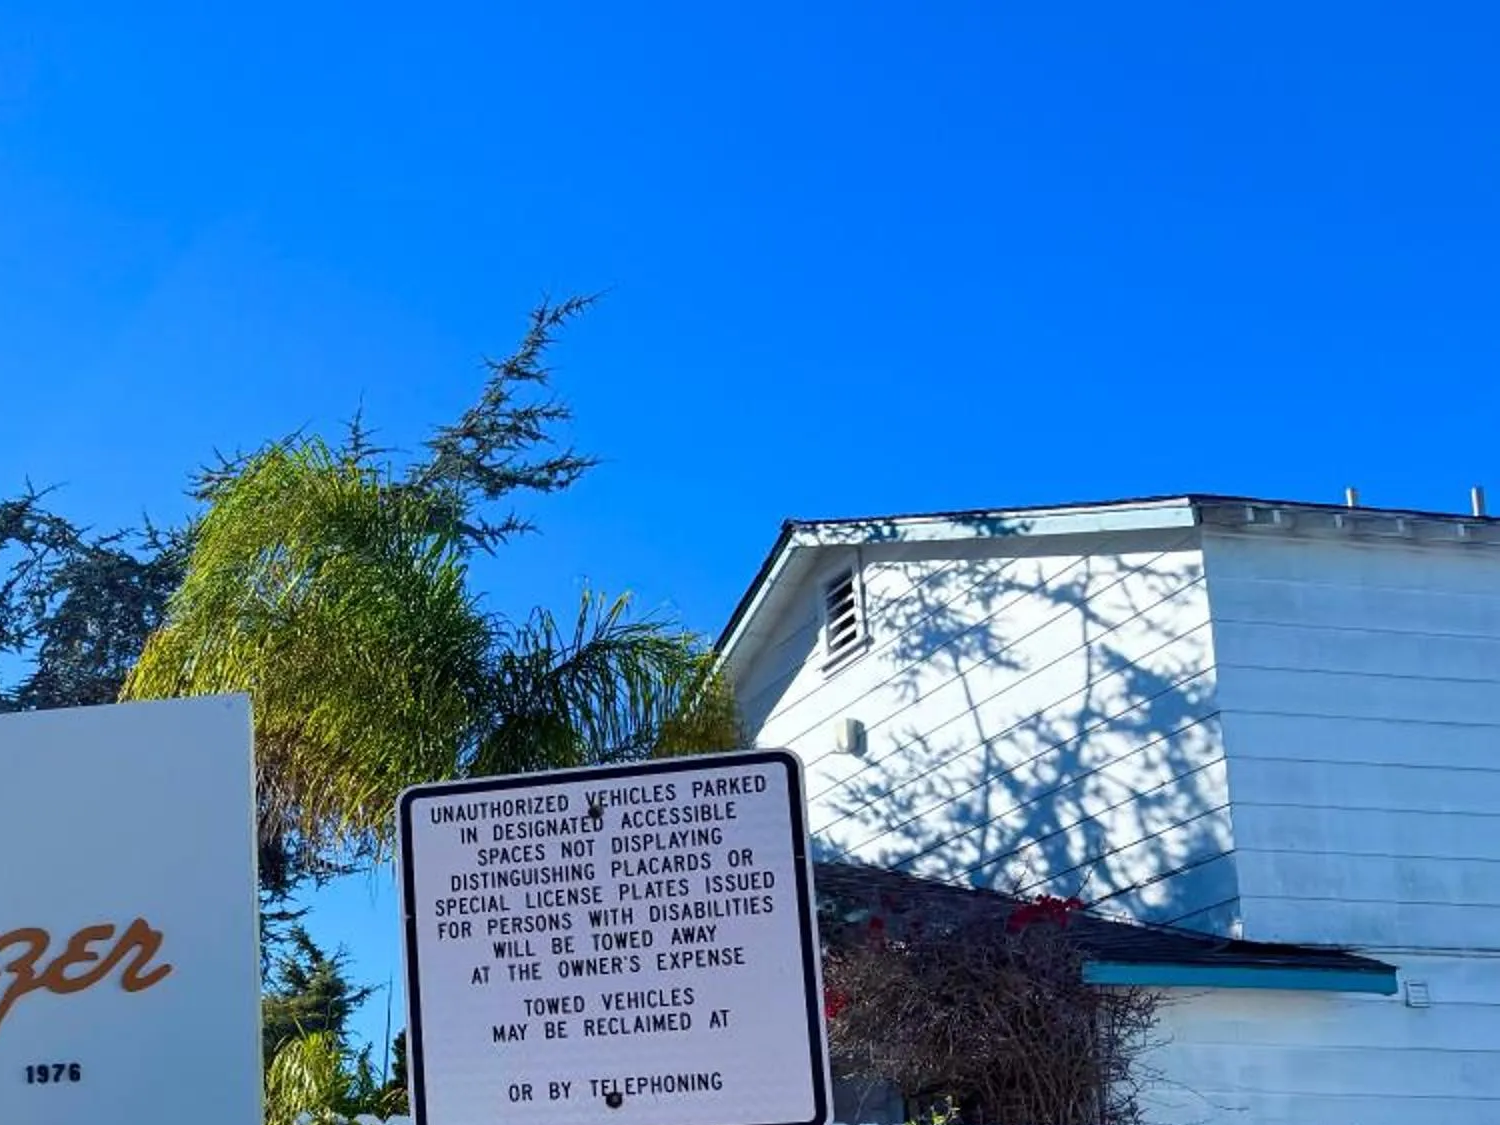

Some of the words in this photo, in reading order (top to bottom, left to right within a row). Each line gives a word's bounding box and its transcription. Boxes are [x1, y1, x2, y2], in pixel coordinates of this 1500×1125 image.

[431, 794, 569, 825] UNAUTHORIZED
[585, 783, 676, 809] VEHICLES
[691, 775, 766, 800] PARKED
[460, 827, 478, 845] IN
[493, 814, 603, 841] DESIGNATED
[621, 802, 737, 829] ACCESSIBLE
[477, 845, 546, 866] SPACES
[560, 840, 595, 858] NOT
[611, 828, 723, 853] DISPLAYING
[451, 863, 595, 891] DISTINGUISHING
[611, 854, 711, 879] PLACARDS
[728, 849, 753, 867] OR
[434, 895, 510, 917] SPECIAL
[525, 886, 602, 909] LICENSE
[619, 880, 690, 901] PLATES
[705, 872, 775, 894] ISSUED
[437, 921, 472, 940] FOR
[487, 913, 572, 935] PERSONS
[588, 909, 634, 928] WITH
[649, 897, 774, 923] DISABILITIES
[492, 940, 536, 959] WILL
[551, 937, 575, 954] BE
[592, 929, 654, 951] TOWED
[671, 925, 718, 944] AWAY
[471, 966, 490, 985] AT
[508, 962, 543, 981] THE
[558, 955, 641, 978] OWNER'S
[657, 947, 746, 970] EXPENSE
[524, 995, 585, 1016] TOWED
[600, 987, 695, 1011] VEHICLES
[492, 1024, 528, 1043] MAY
[544, 1021, 568, 1039] BE
[584, 1013, 692, 1037] RECLAIMED
[709, 1010, 730, 1029] AT
[25, 1063, 82, 1085] 1976
[508, 1084, 533, 1102] OR
[549, 1082, 572, 1100] BY
[589, 1072, 723, 1098] TELEPHONING
